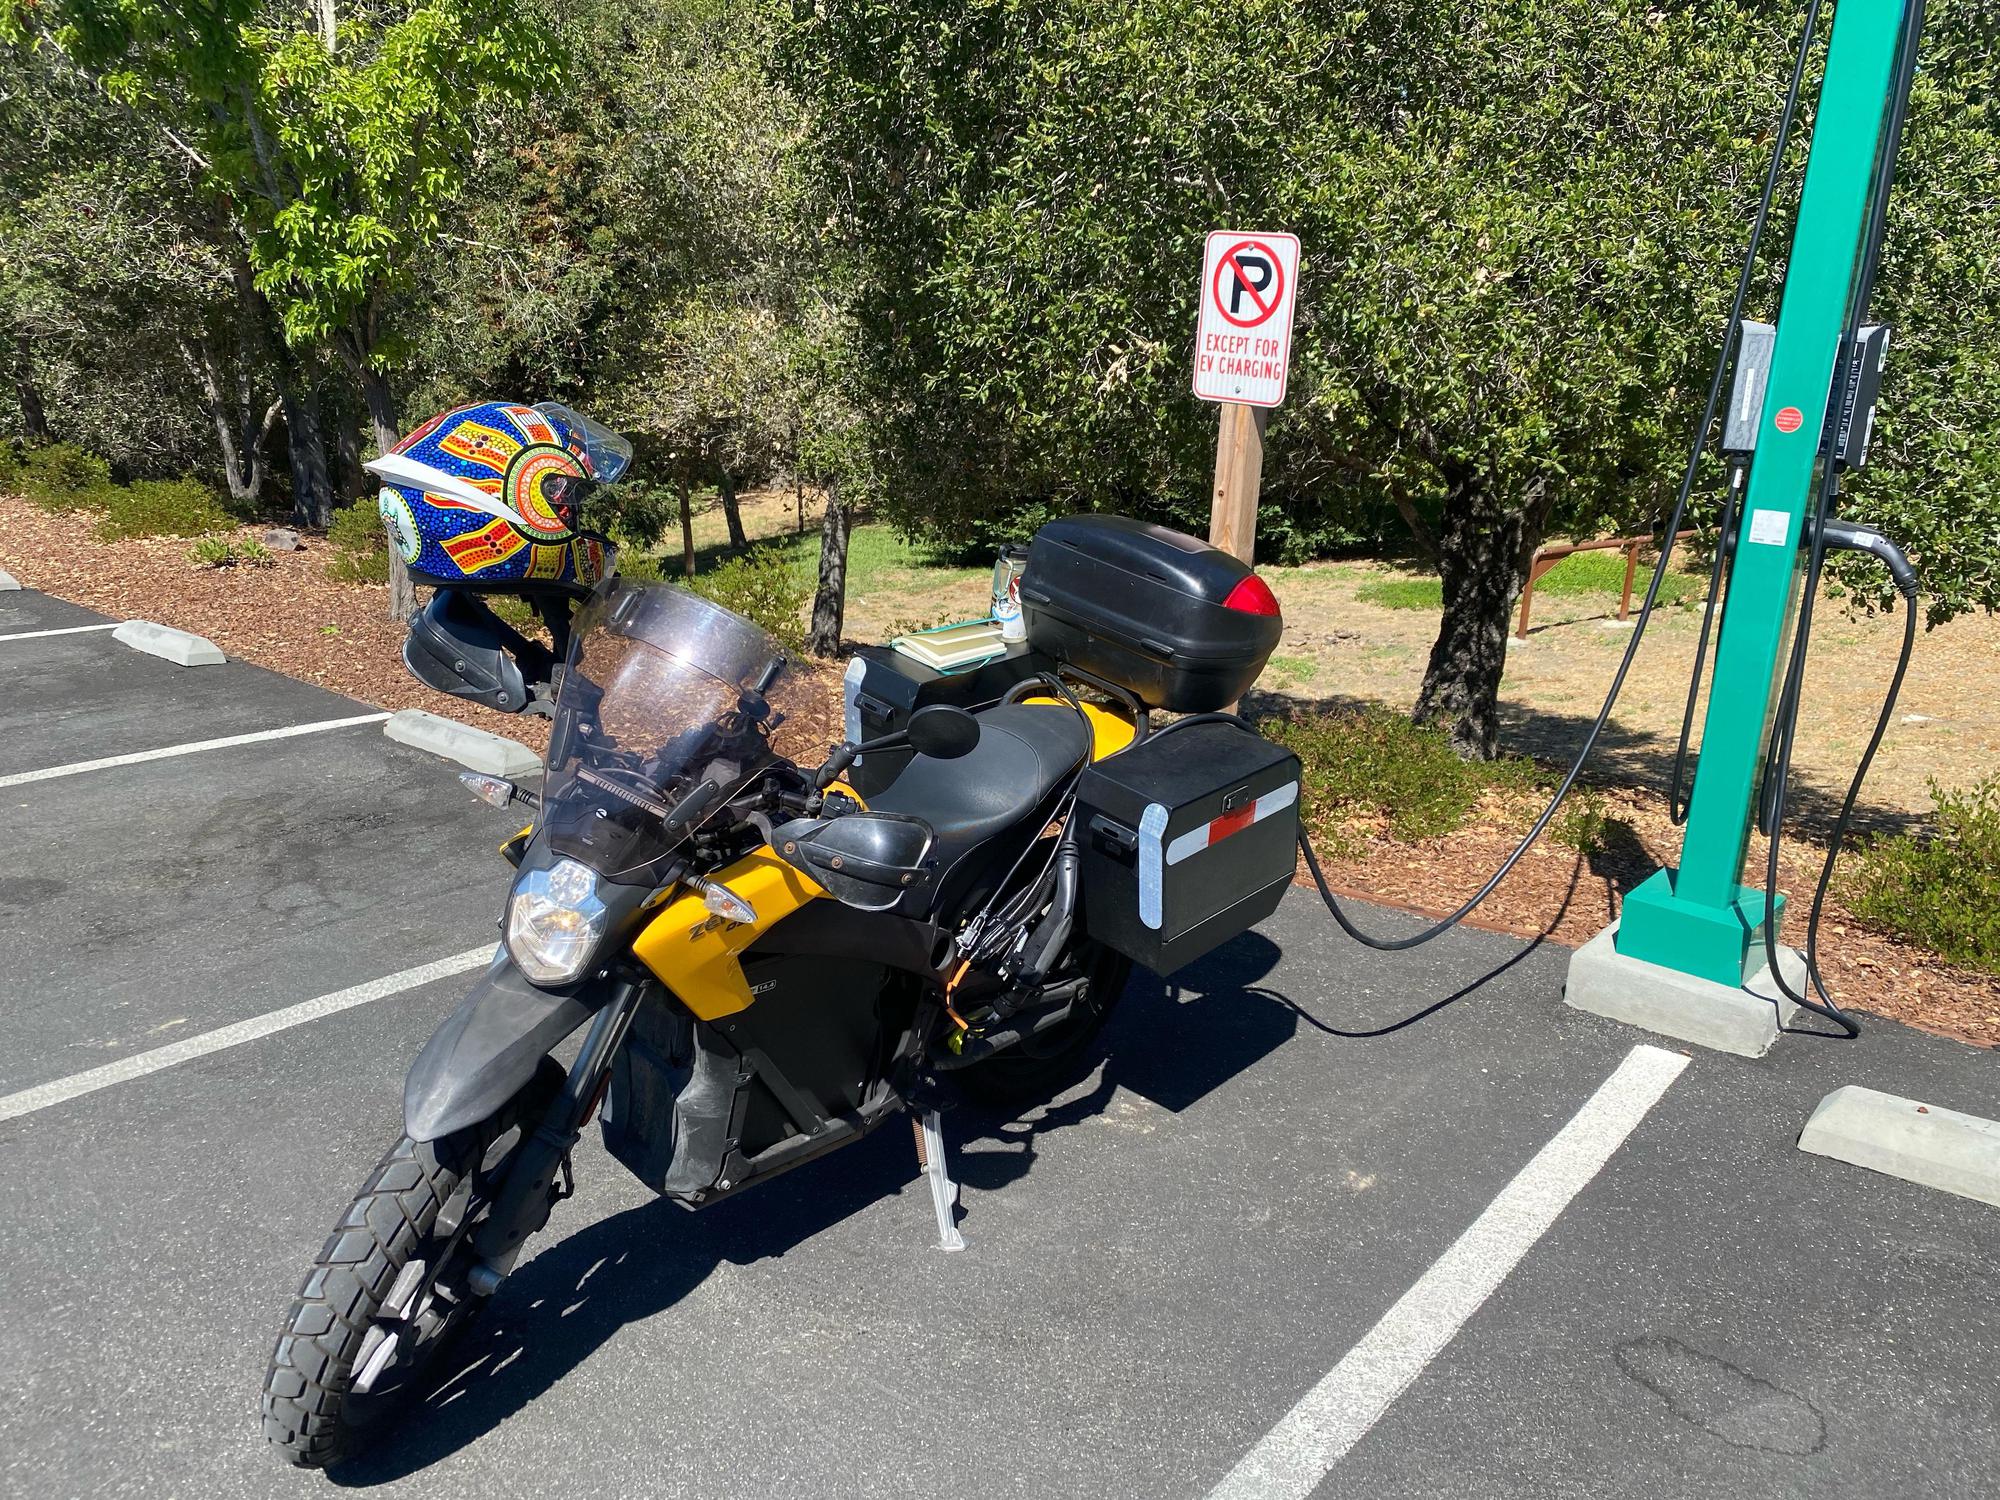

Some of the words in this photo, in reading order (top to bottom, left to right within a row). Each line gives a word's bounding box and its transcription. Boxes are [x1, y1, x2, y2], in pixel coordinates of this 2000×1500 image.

[1230, 255, 1272, 313] P
[1206, 333, 1249, 354] EXCEPT
[1255, 338, 1279, 357] FOR
[1200, 354, 1214, 372] EV
[1219, 356, 1281, 380] CHARGING
